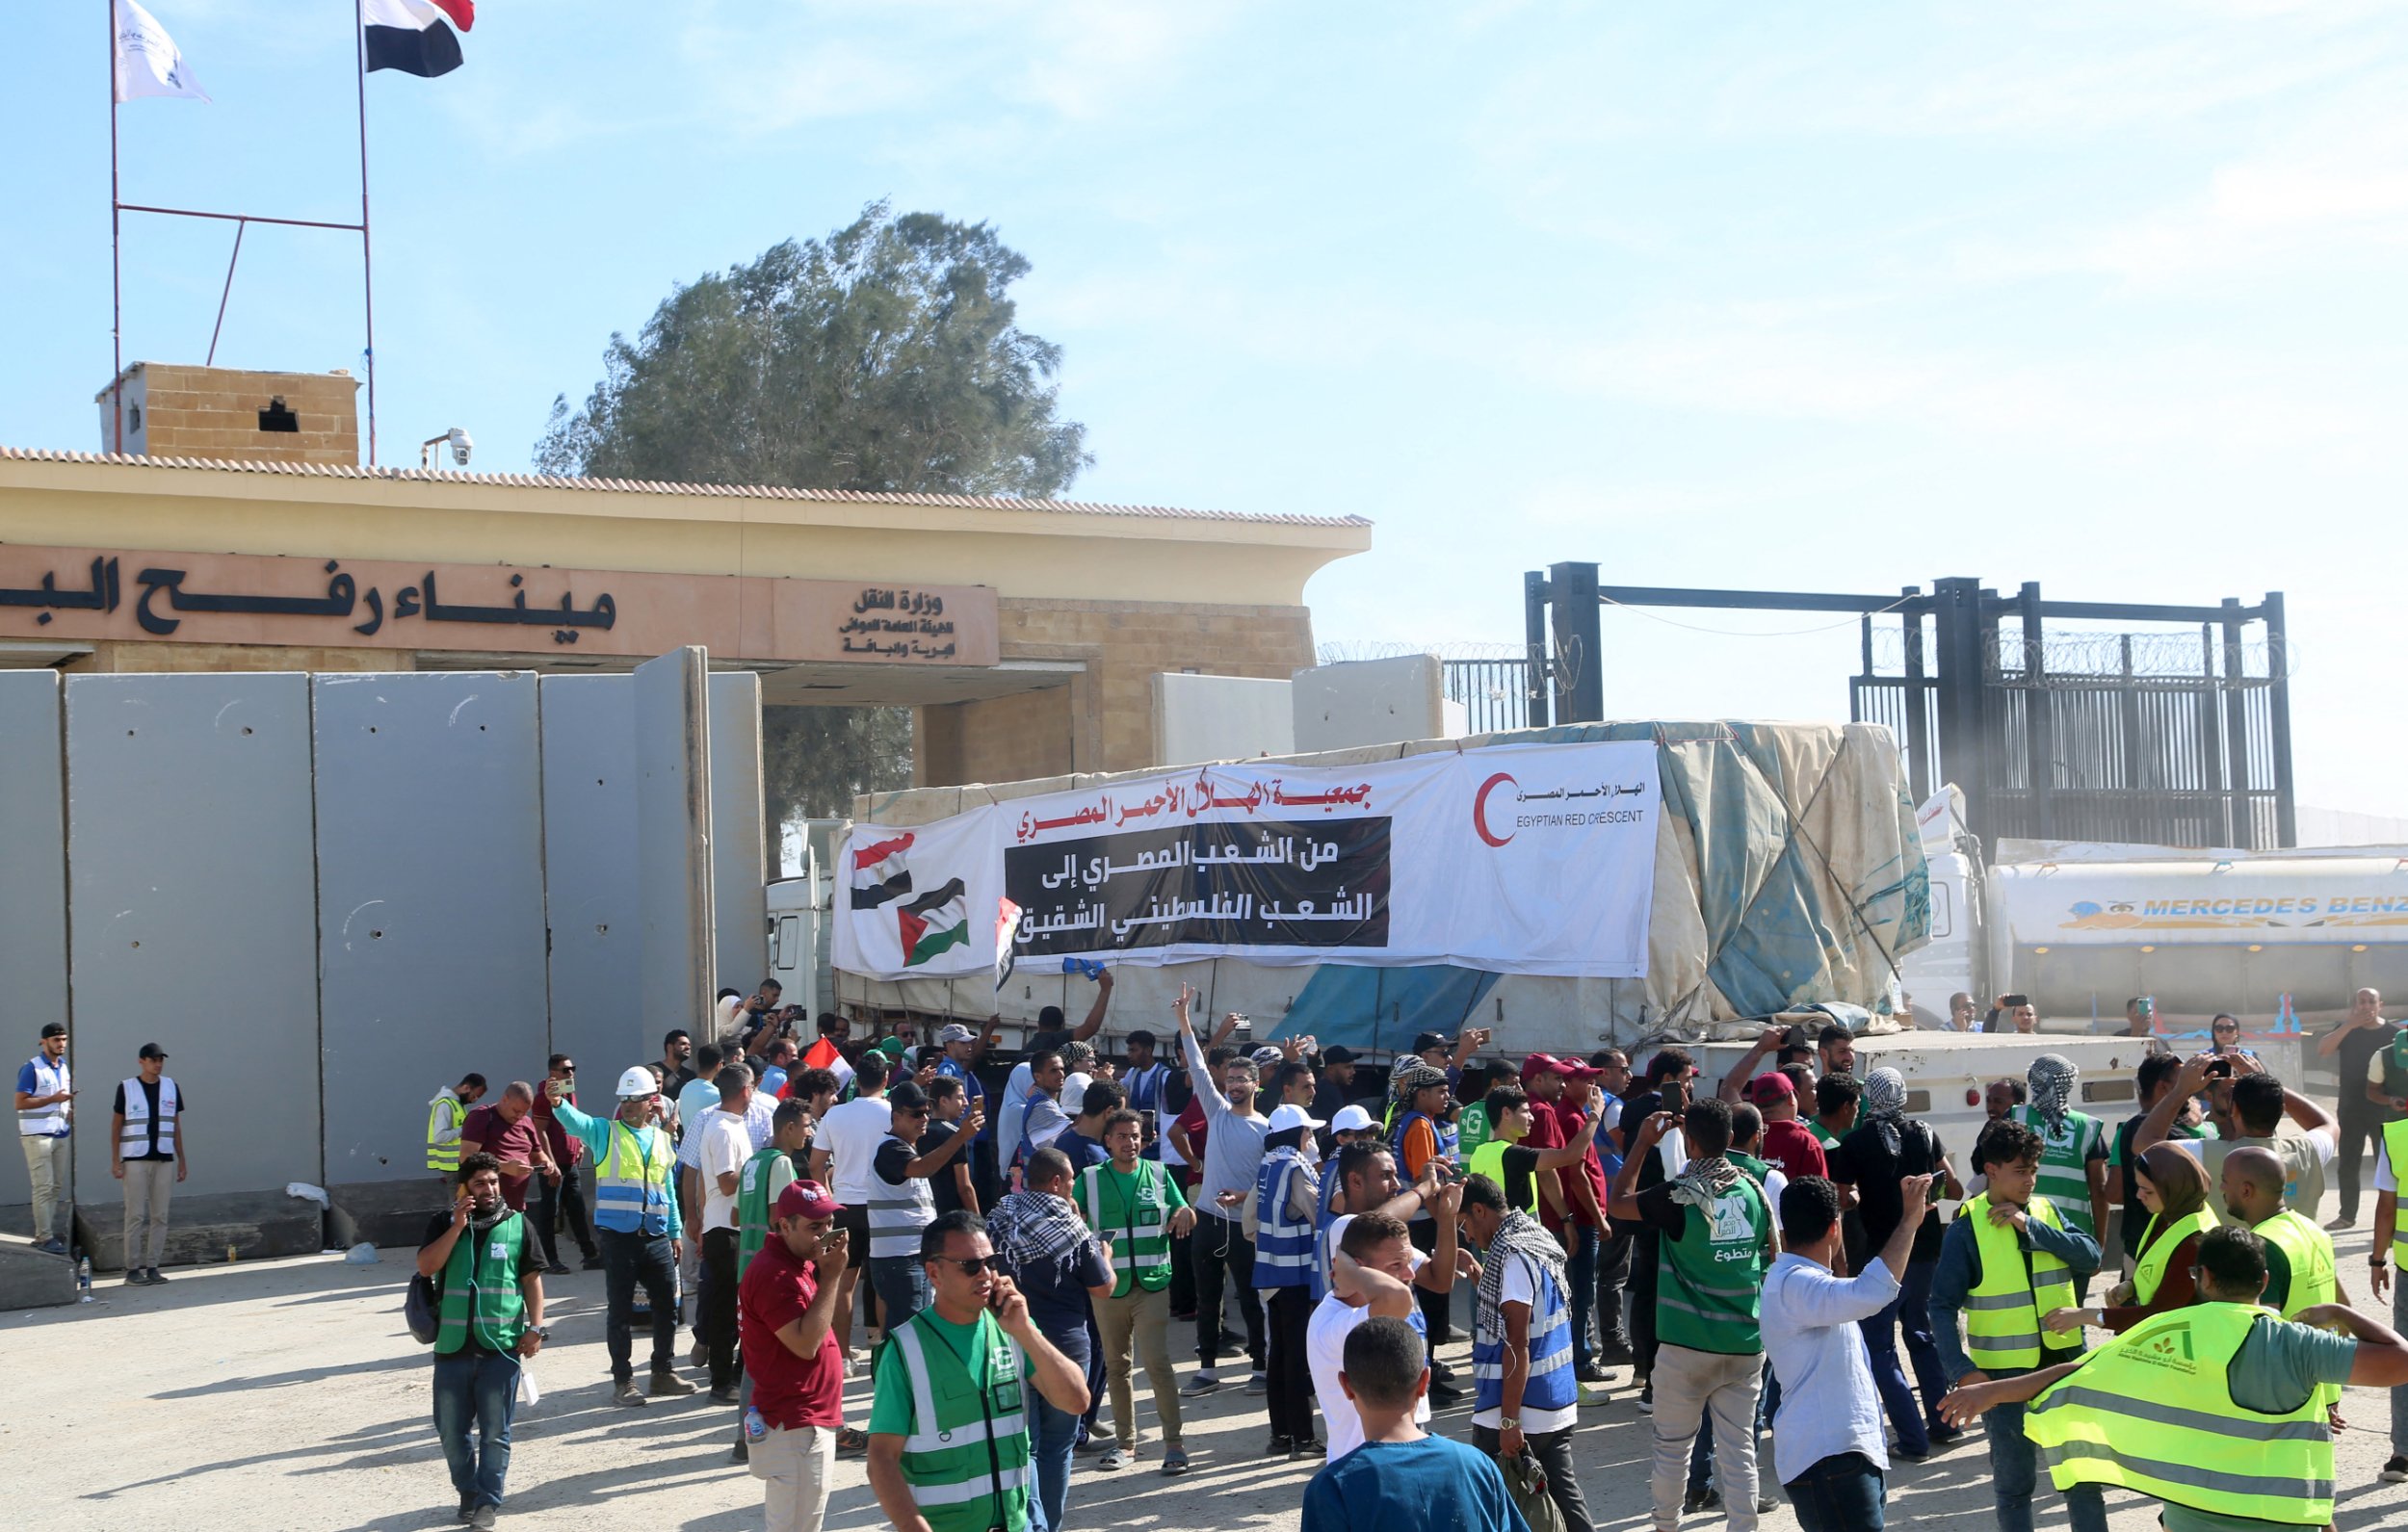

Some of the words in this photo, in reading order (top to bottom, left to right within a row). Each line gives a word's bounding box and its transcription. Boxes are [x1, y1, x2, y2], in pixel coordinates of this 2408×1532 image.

[136, 559, 383, 636] رفح
[394, 568, 616, 646] ميناء
[854, 587, 895, 614] النقل
[900, 589, 944, 616] وزارة
[880, 619, 918, 634] العامة
[919, 618, 954, 637] الهيئة
[842, 637, 909, 658] والجافة
[911, 639, 955, 660] البرية
[1113, 777, 1186, 829] الأحمر
[1186, 778, 1270, 818] الهلال
[1271, 777, 1373, 814] جمعية
[1565, 781, 1610, 801] الأحمر
[1610, 781, 1645, 798] الهلال
[1016, 794, 1114, 844] المصري
[1516, 815, 1563, 828] EGYPTIAN
[1564, 813, 1585, 826] RED
[1587, 809, 1644, 825] CRESCENT
[1083, 840, 1190, 893] المصري
[1191, 830, 1294, 872] الشعب
[1299, 836, 1339, 872] من
[1041, 853, 1078, 891] إلى
[1014, 897, 1106, 944] الشقيق
[1112, 891, 1252, 943] الفلسطيني
[1259, 885, 1373, 929] الشعب
[2142, 896, 2318, 916] MERCEDES
[2326, 896, 2408, 914] BENZ
[1714, 1247, 1753, 1262] متطوع
